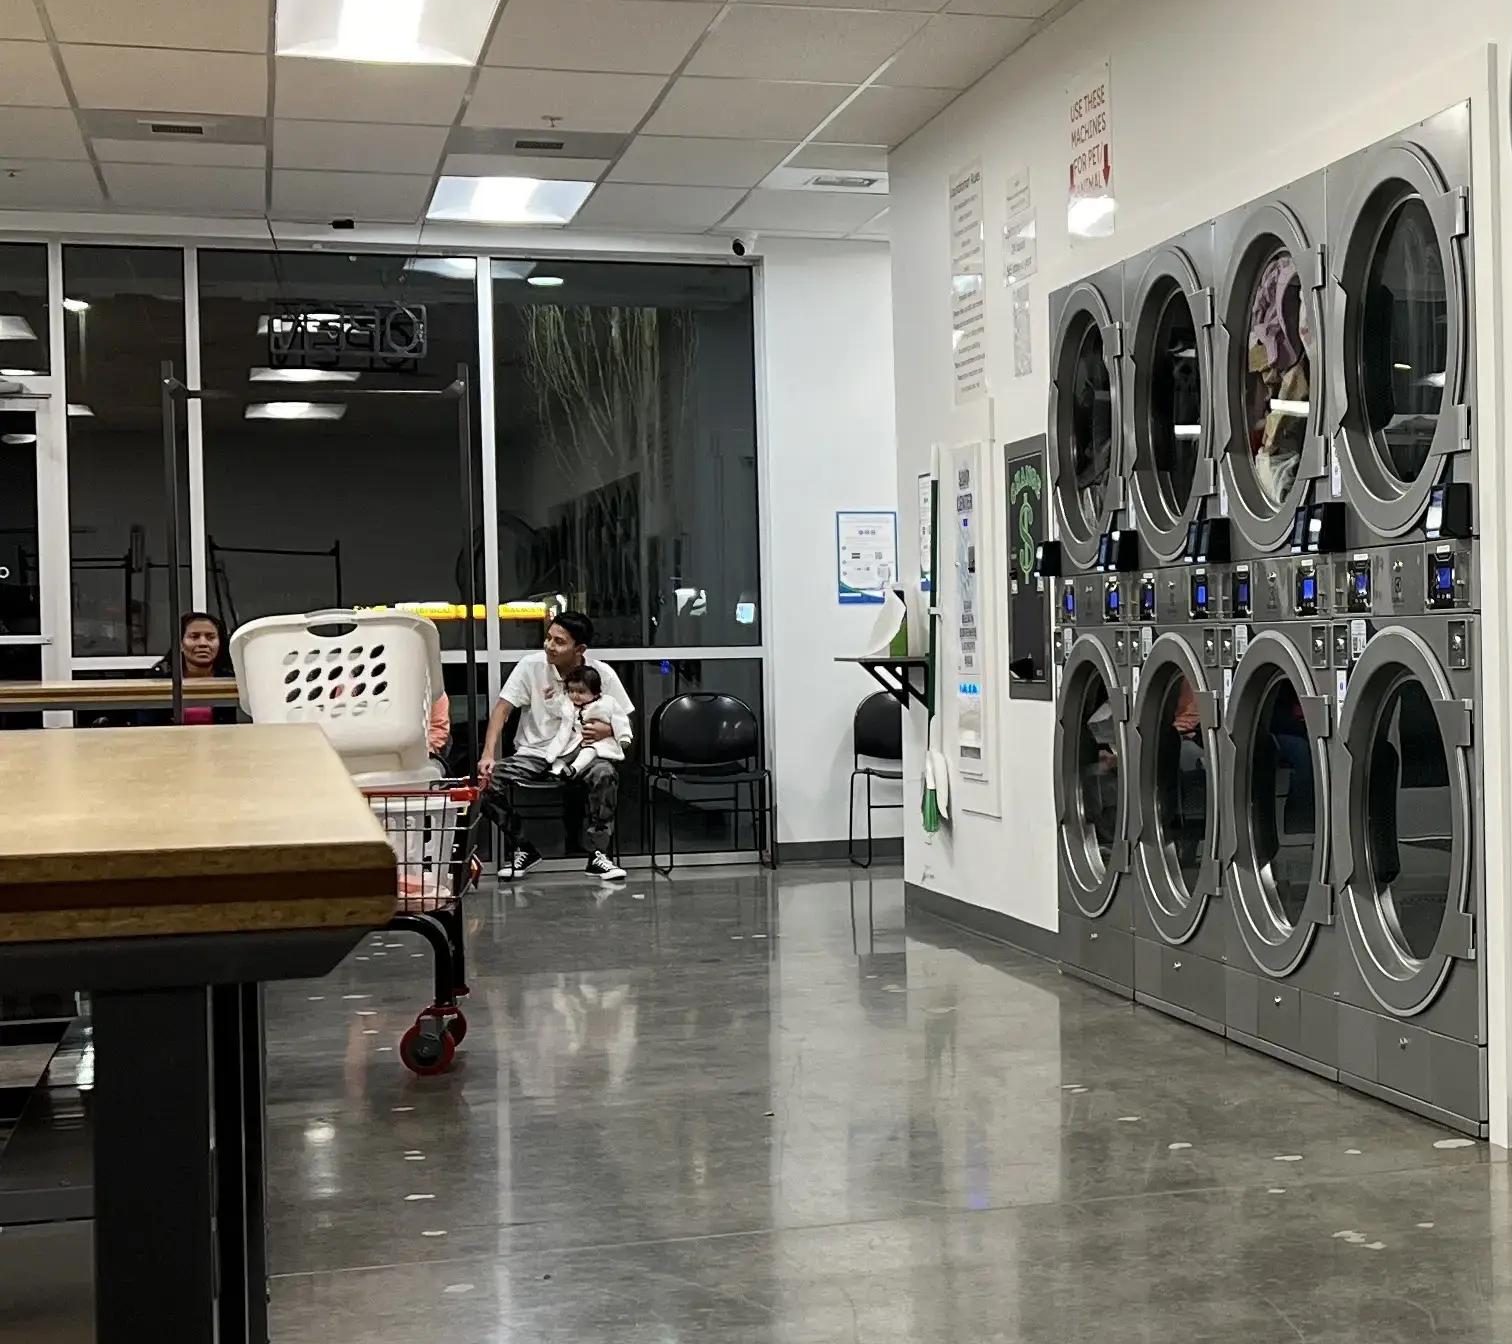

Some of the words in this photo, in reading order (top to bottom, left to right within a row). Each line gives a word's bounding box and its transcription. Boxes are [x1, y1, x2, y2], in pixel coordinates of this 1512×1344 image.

[1070, 98, 1083, 123] USE
[1084, 84, 1106, 112] THESE
[1071, 111, 1107, 148] MACHINES
[1073, 153, 1087, 175] FOR
[1075, 170, 1103, 197] ANIMAL
